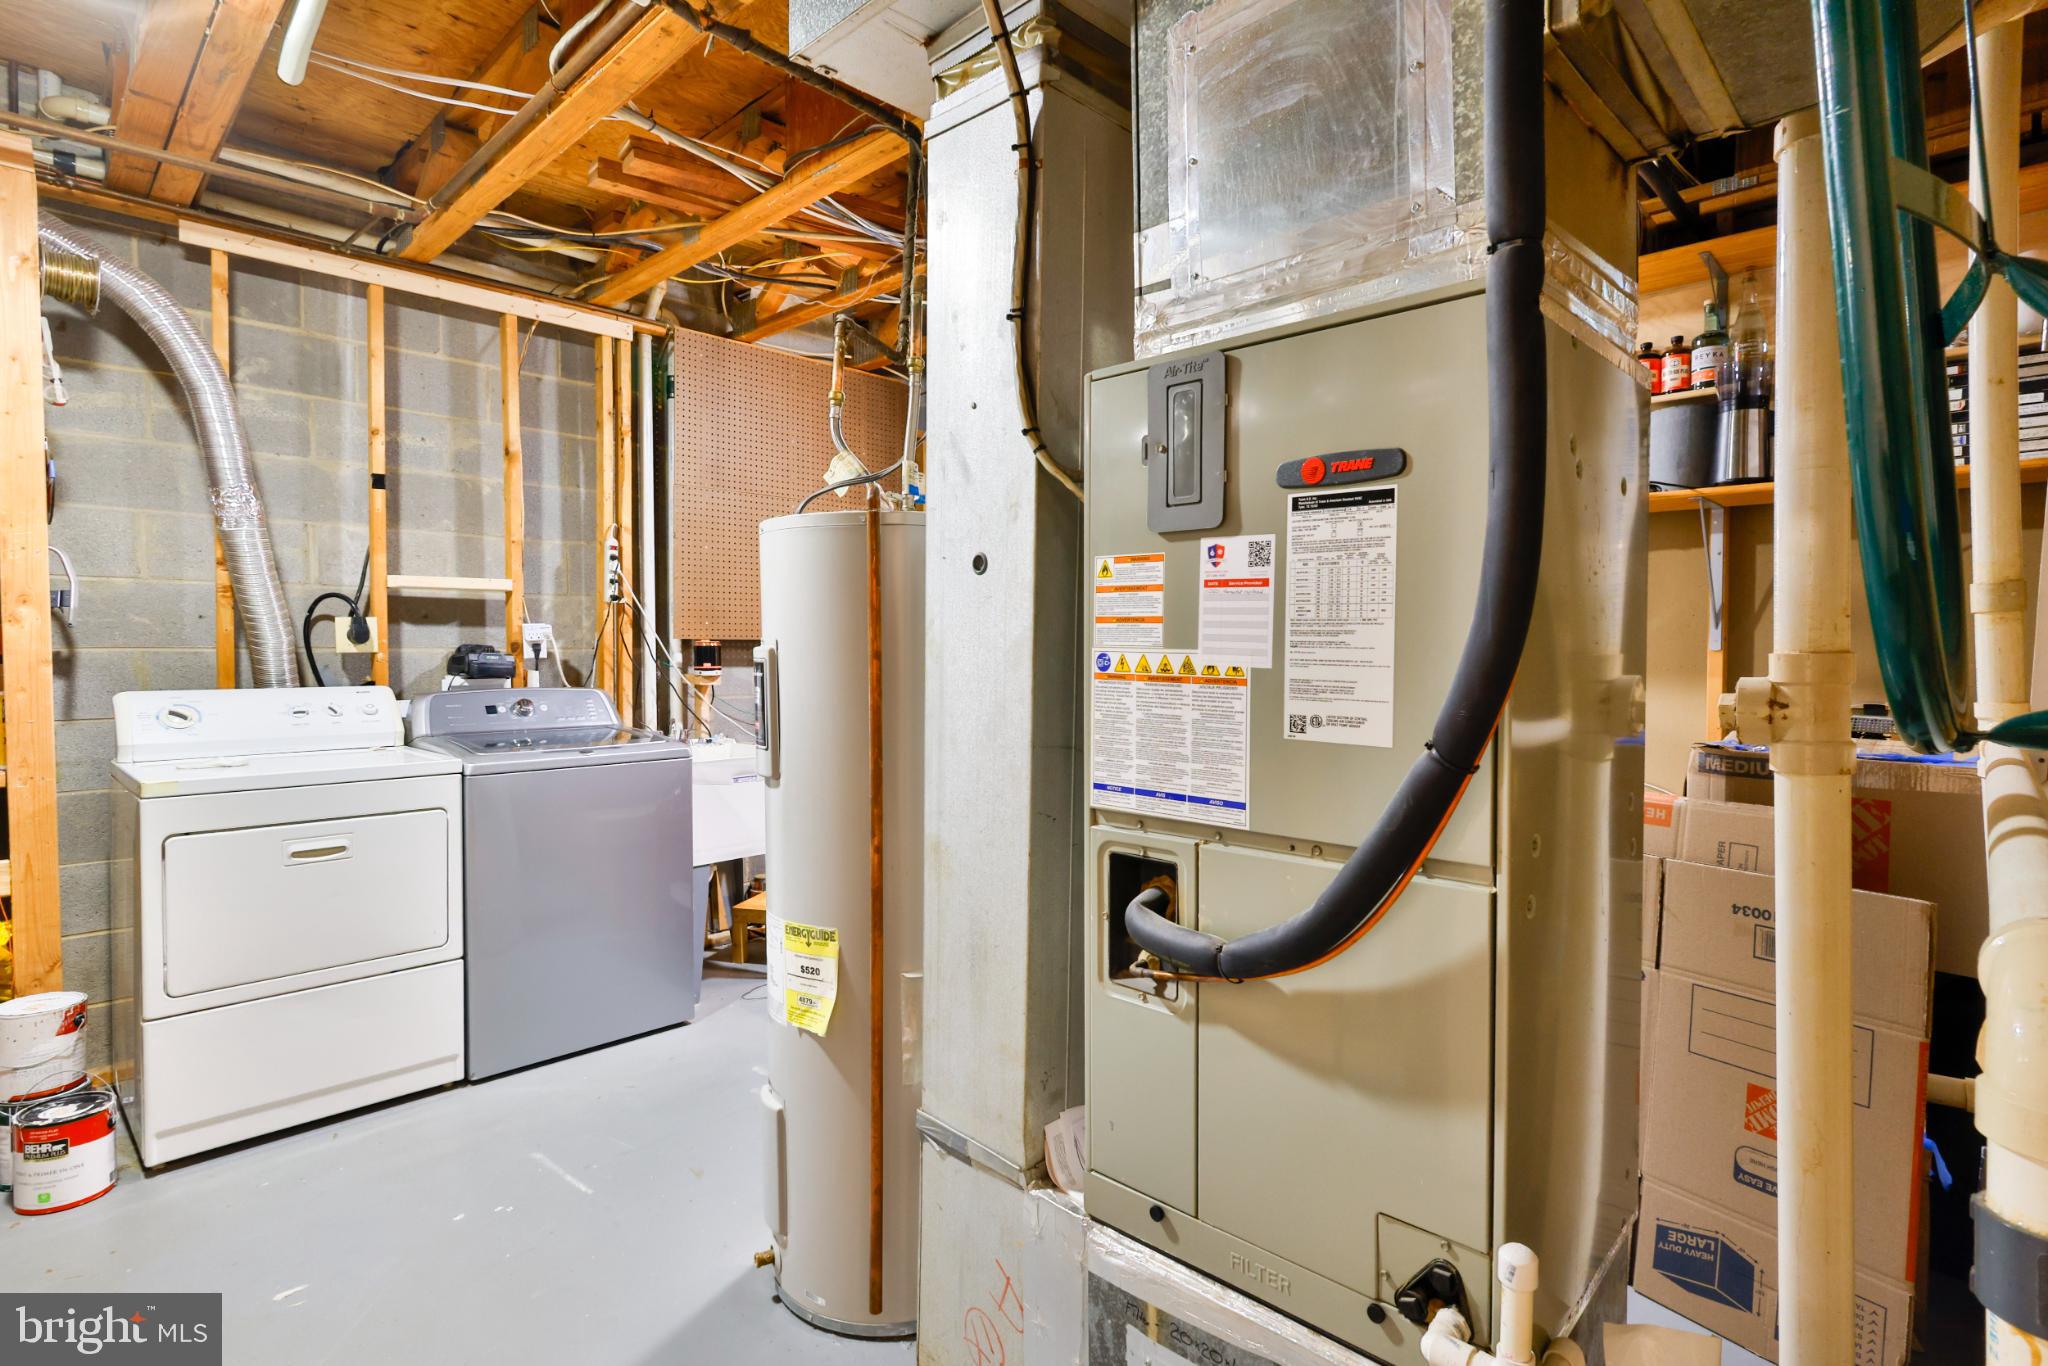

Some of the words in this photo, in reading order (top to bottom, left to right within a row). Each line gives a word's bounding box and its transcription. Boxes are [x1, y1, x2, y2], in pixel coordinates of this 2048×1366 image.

[1331, 457, 1375, 473] TRANE
[800, 965, 820, 976] $520
[24, 1143, 52, 1154] BEHR
[1668, 1230, 1715, 1251] LARGE
[1658, 1241, 1682, 1253] DUTY
[1684, 1249, 1713, 1261] HEAVY
[1230, 1252, 1292, 1296] FILTER
